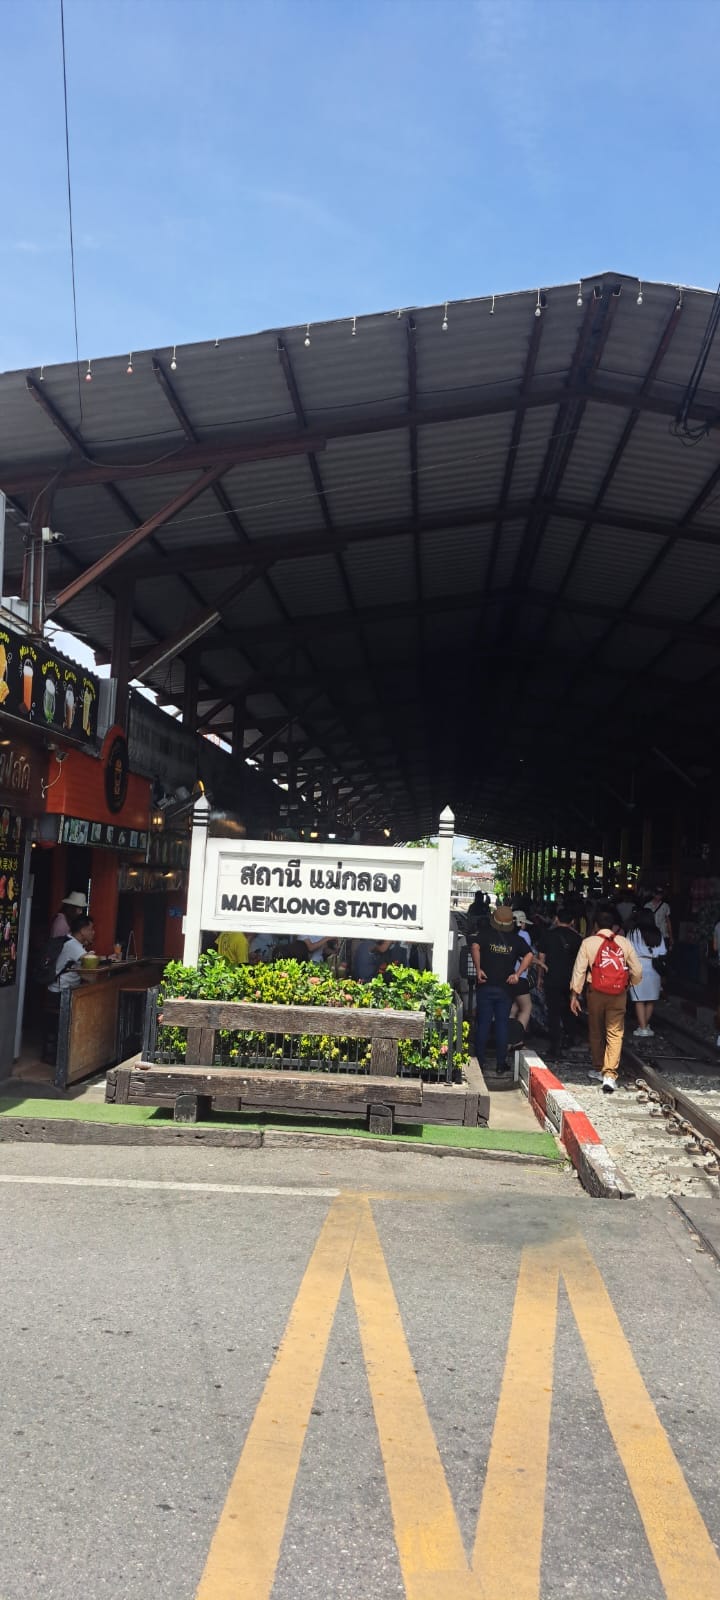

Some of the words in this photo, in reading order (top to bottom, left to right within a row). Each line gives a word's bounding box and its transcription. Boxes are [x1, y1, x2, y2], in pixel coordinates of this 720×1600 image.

[240, 859, 302, 888] สถานี
[310, 861, 401, 893] แม่กลอง
[221, 894, 330, 915] MAEKLONG
[333, 900, 417, 921] STATION
